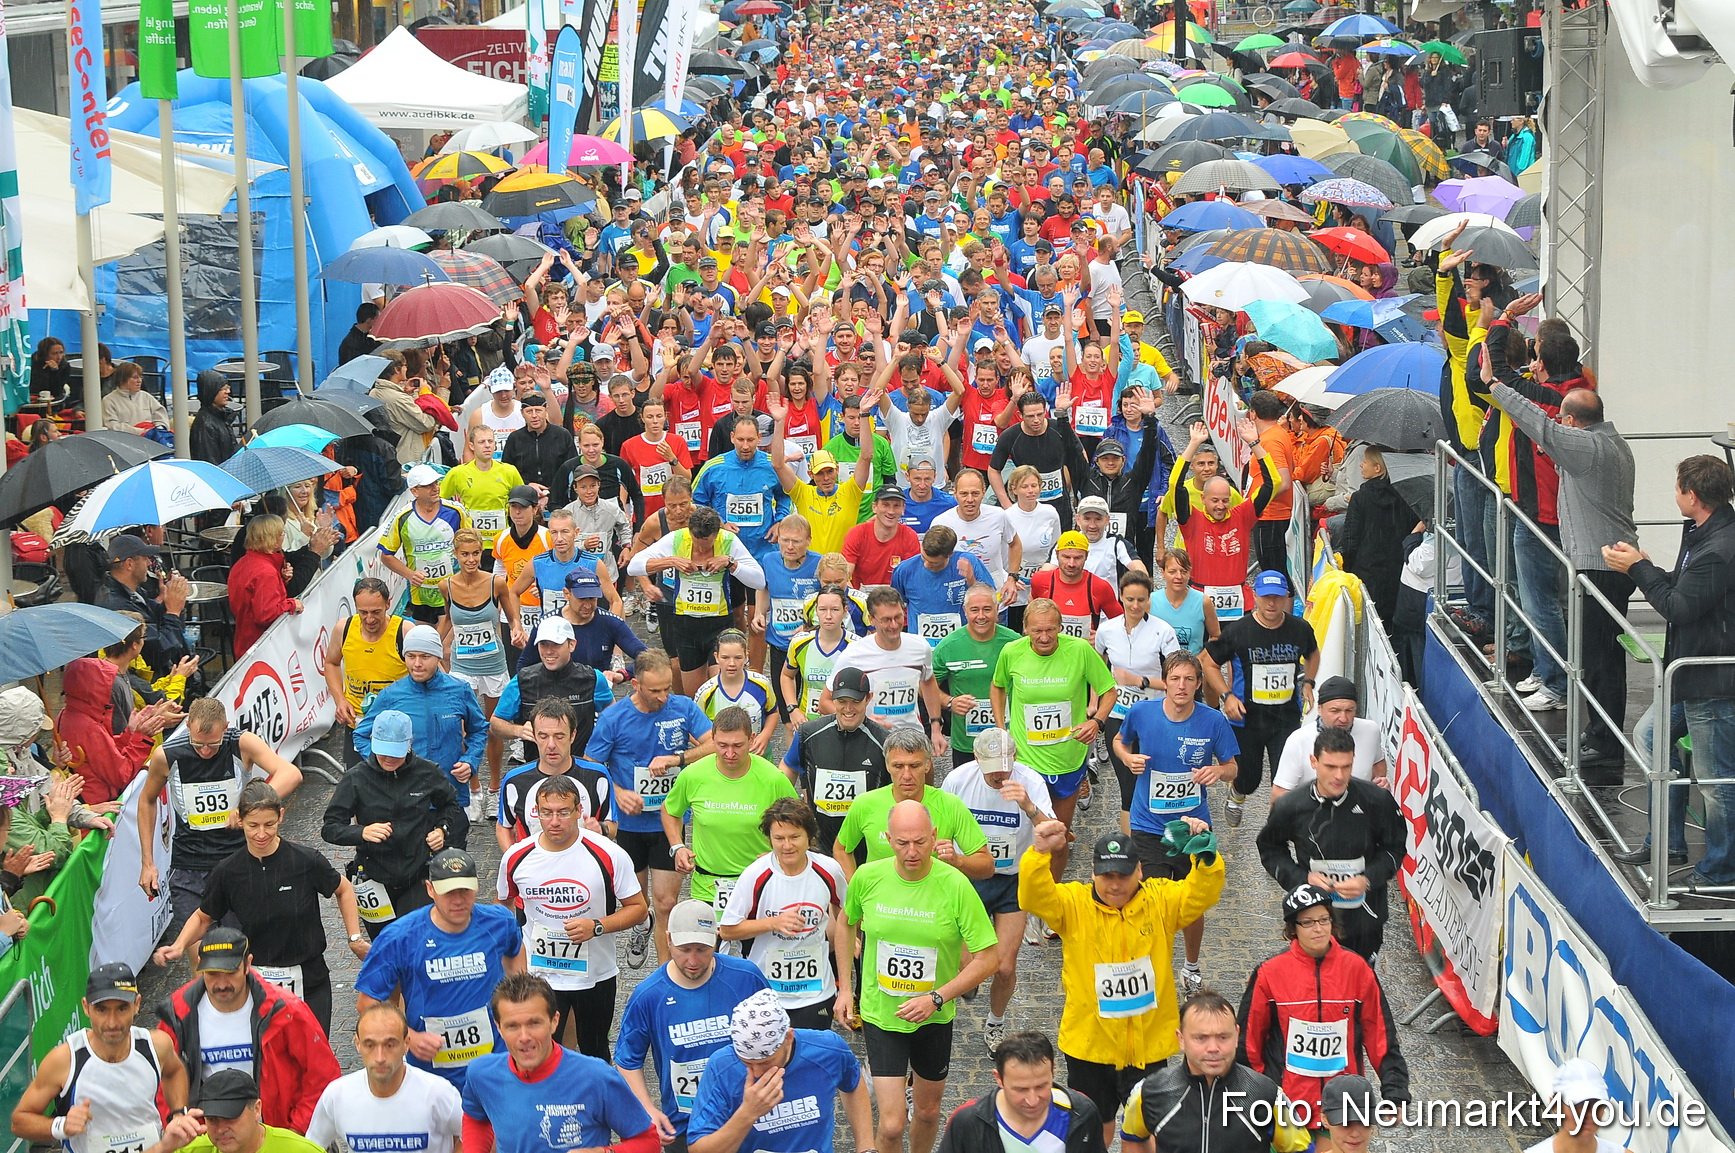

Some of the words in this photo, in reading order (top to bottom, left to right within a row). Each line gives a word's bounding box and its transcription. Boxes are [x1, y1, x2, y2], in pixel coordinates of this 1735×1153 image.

[378, 109, 475, 121] www.audibkk.de
[647, 471, 667, 485] 826
[730, 503, 759, 515] 2561
[424, 565, 446, 579] 320
[687, 589, 713, 604] 319
[686, 604, 711, 612] Friedrich
[459, 630, 493, 647] 2279
[1262, 674, 1288, 690] 154
[878, 688, 915, 705] 2178
[1033, 713, 1061, 731] 671
[1042, 732, 1056, 741] Fritz
[825, 782, 857, 801] 234
[1155, 781, 1197, 800] 2292
[195, 793, 229, 814] 593
[200, 814, 226, 825] Jürgen
[525, 886, 576, 896] GERHART
[535, 937, 584, 961] 3177
[425, 952, 486, 974] HUBER
[771, 958, 818, 980] 3126
[887, 957, 925, 981] 633
[779, 982, 808, 992] Tamara
[891, 981, 916, 992] Ulrich
[1101, 972, 1149, 998] 3401
[668, 1015, 731, 1040] HUBER
[441, 1024, 482, 1050] 148
[683, 1029, 731, 1045] TECHNOLOGY
[1293, 1033, 1343, 1058] 3402
[767, 1110, 818, 1127] TECHNOLOGY
[355, 1136, 423, 1151] STAEDTLER
